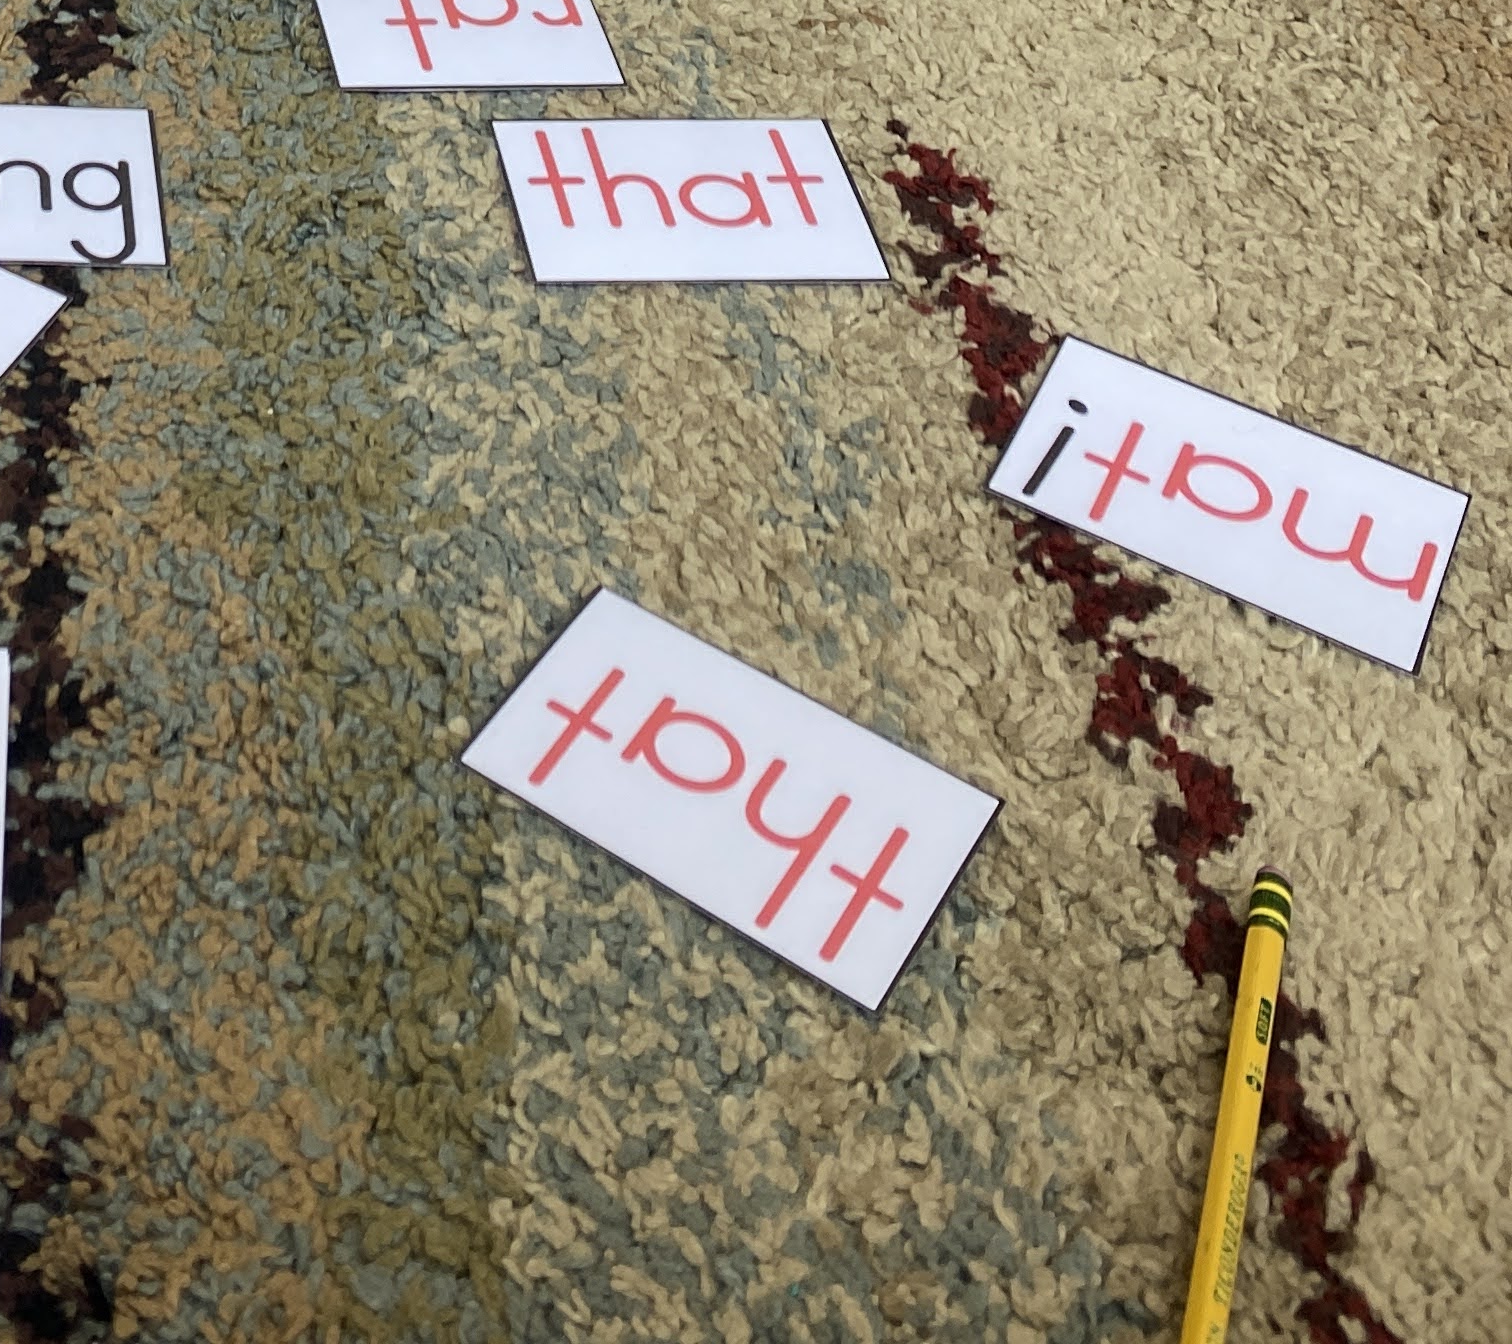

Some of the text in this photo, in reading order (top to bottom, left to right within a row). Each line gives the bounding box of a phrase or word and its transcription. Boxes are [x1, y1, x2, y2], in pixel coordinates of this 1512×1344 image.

[526, 127, 825, 229] that
[1021, 397, 1441, 604] mat!
[526, 665, 911, 964] that
[1257, 999, 1272, 1041] SOFT
